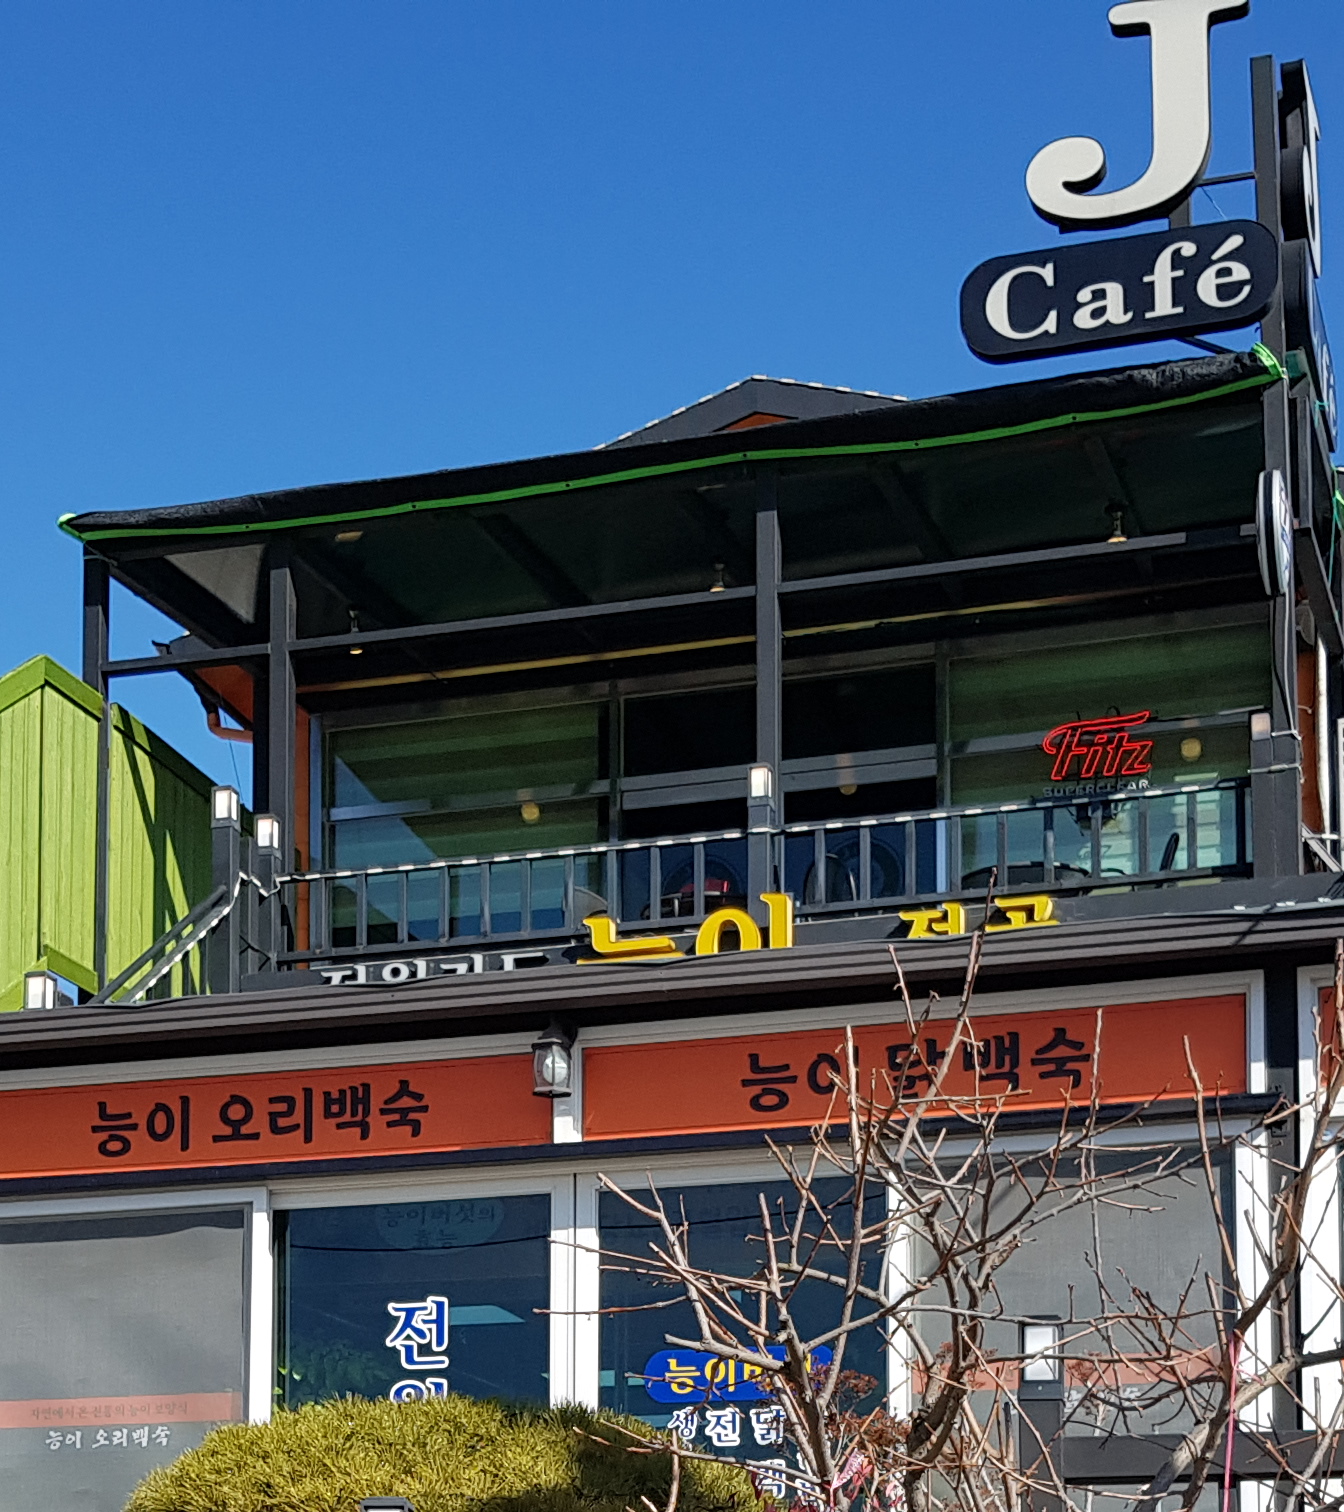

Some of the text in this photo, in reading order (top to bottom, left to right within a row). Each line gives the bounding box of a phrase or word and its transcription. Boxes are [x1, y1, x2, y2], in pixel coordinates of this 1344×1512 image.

[1025, 0, 1250, 219] J
[985, 234, 1252, 340] Café
[1042, 710, 1153, 780] Fitz
[741, 1028, 1090, 1112] 능이 닭백숙
[91, 1079, 430, 1158] 능이 오리백숙
[45, 1426, 171, 1450] 능이 오리백숙
